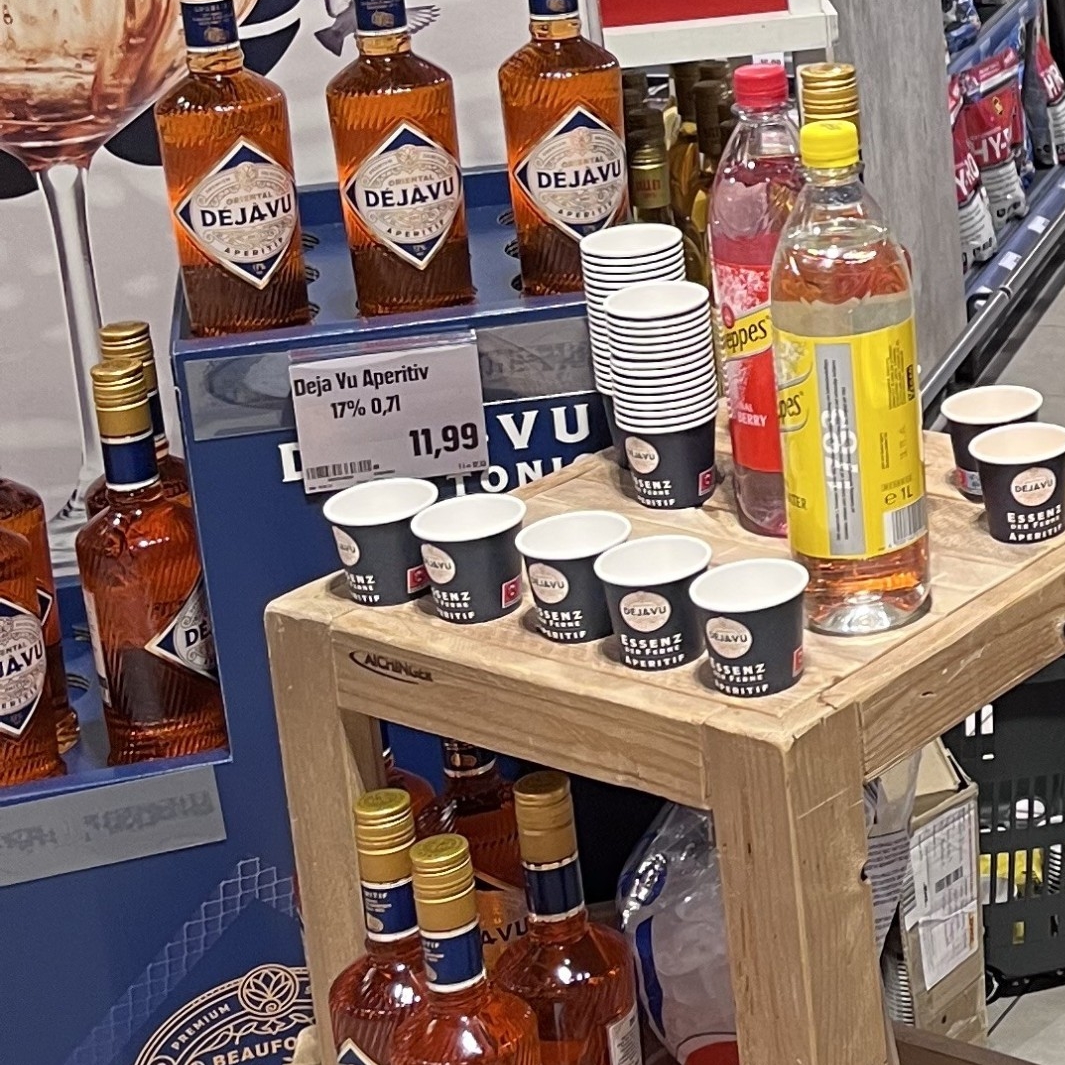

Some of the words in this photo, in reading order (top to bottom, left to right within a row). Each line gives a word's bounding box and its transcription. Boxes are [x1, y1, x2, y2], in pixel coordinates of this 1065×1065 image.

[390, 174, 434, 186] ORIENTAL
[386, 219, 444, 237] APERITIF
[224, 236, 284, 256] APERITIF
[294, 378, 332, 398] Deja
[335, 372, 357, 390] Vu
[362, 363, 429, 388] Aperitiv
[330, 399, 366, 419] 17%
[409, 422, 479, 459] 11,99
[1007, 503, 1063, 524] ESSENZ
[1008, 523, 1064, 542] APERITIF
[620, 632, 683, 649] ESSENZ
[624, 653, 685, 668] APERITIF
[170, 1002, 231, 1052] PREMIUM
